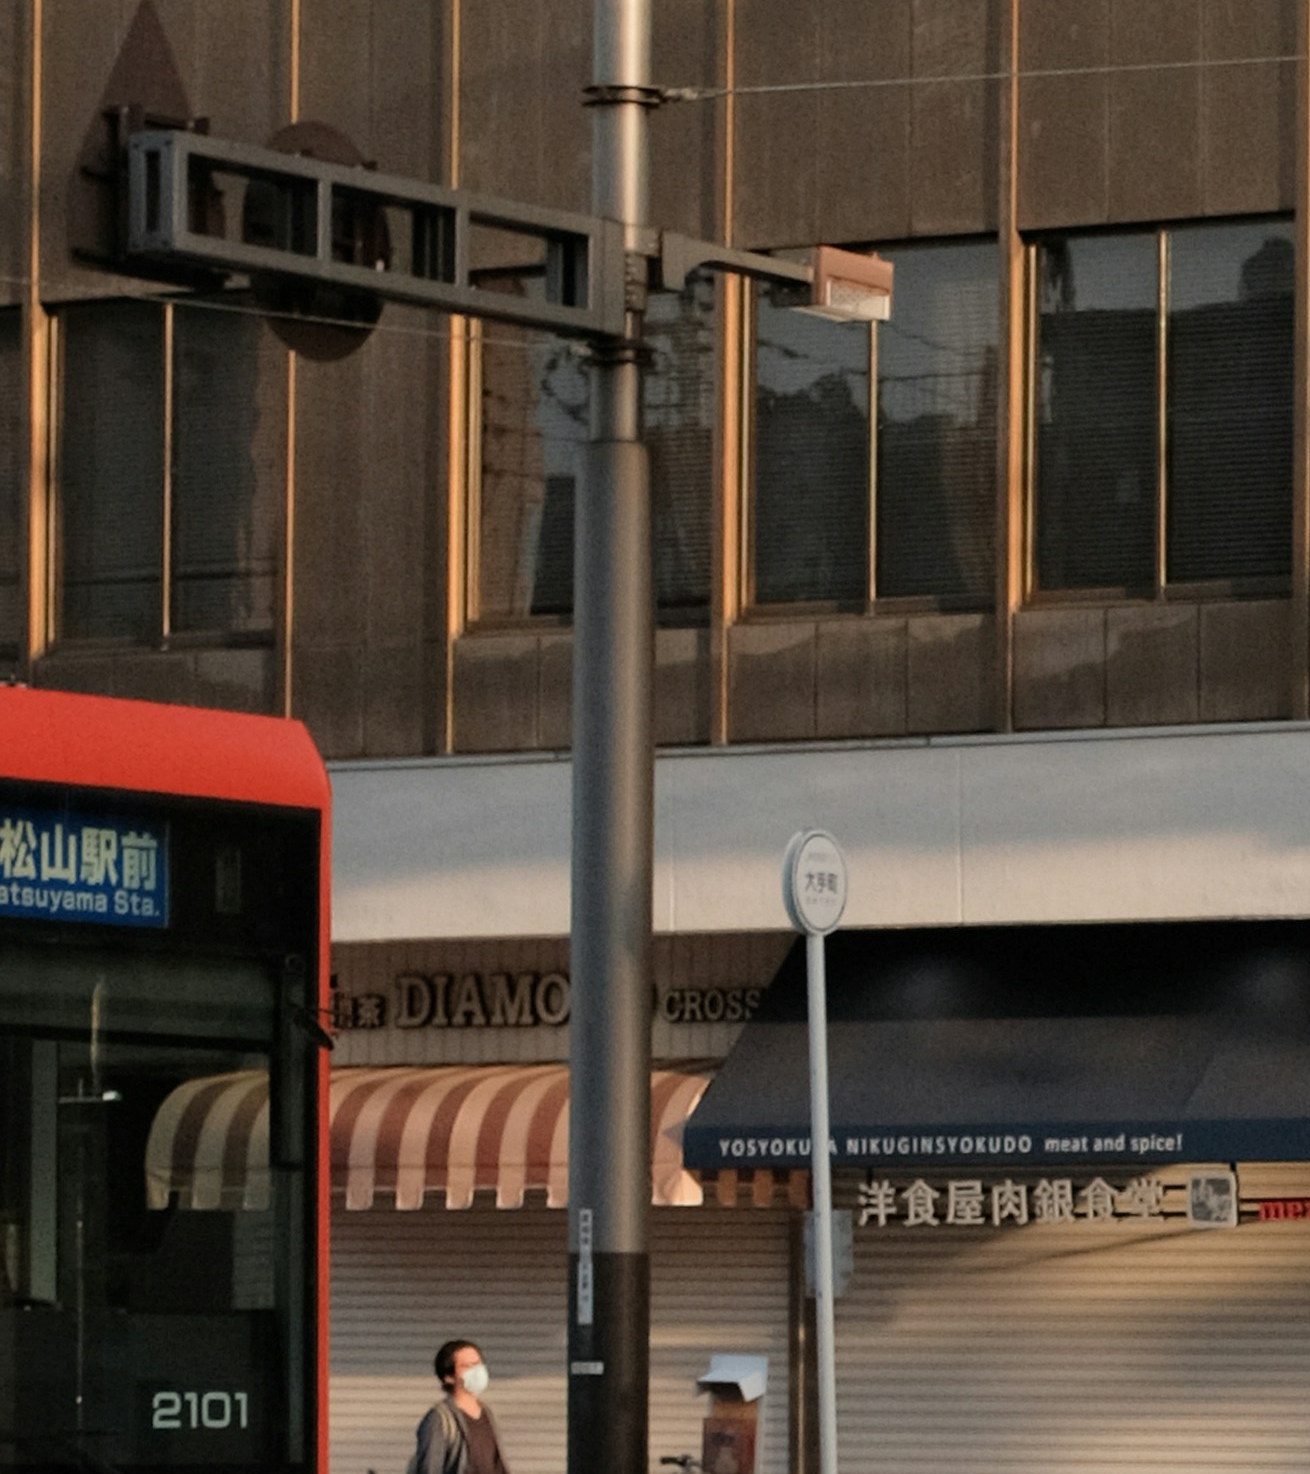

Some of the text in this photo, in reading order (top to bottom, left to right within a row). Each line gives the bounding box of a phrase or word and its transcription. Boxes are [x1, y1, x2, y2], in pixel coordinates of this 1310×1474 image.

[0, 817, 159, 892] 松山駅前
[113, 889, 161, 918] Sta.
[396, 972, 570, 1028] DIAMO
[718, 1132, 1184, 1158] YOSYOKUA NIKUGINSYOKUDO meat and spice!
[857, 1177, 1167, 1228] 洋食屋肉銀食堂
[151, 1391, 249, 1430] 2101
